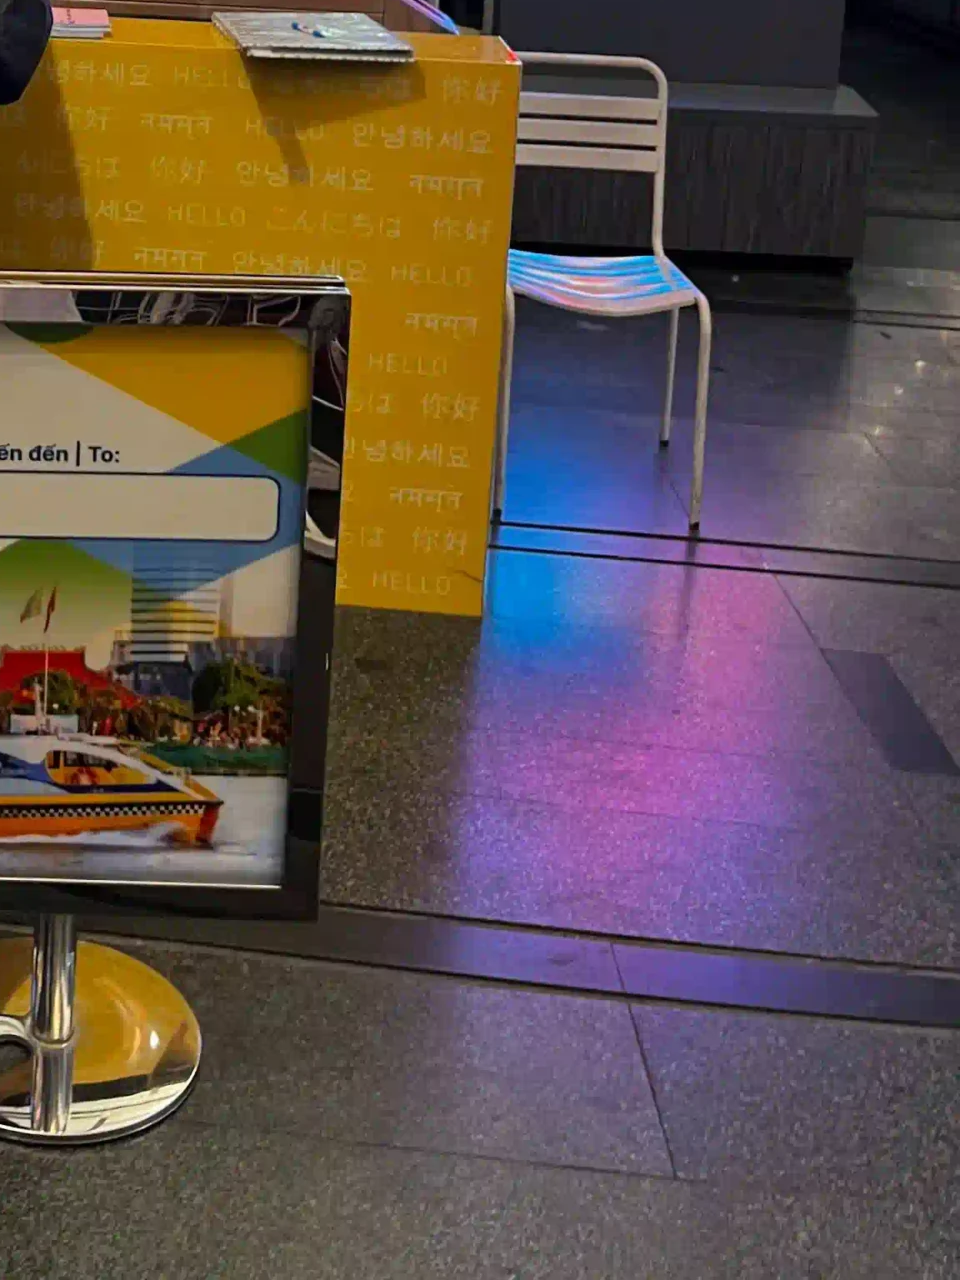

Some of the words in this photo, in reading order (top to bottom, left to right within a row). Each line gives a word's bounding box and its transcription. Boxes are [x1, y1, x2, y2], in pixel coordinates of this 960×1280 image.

[351, 120, 494, 155] 안녕하세요
[166, 204, 247, 229] HELLO
[368, 351, 449, 377] HELLO
[28, 443, 69, 462] đến
[87, 446, 120, 463] To:
[371, 571, 452, 596] HELLO
